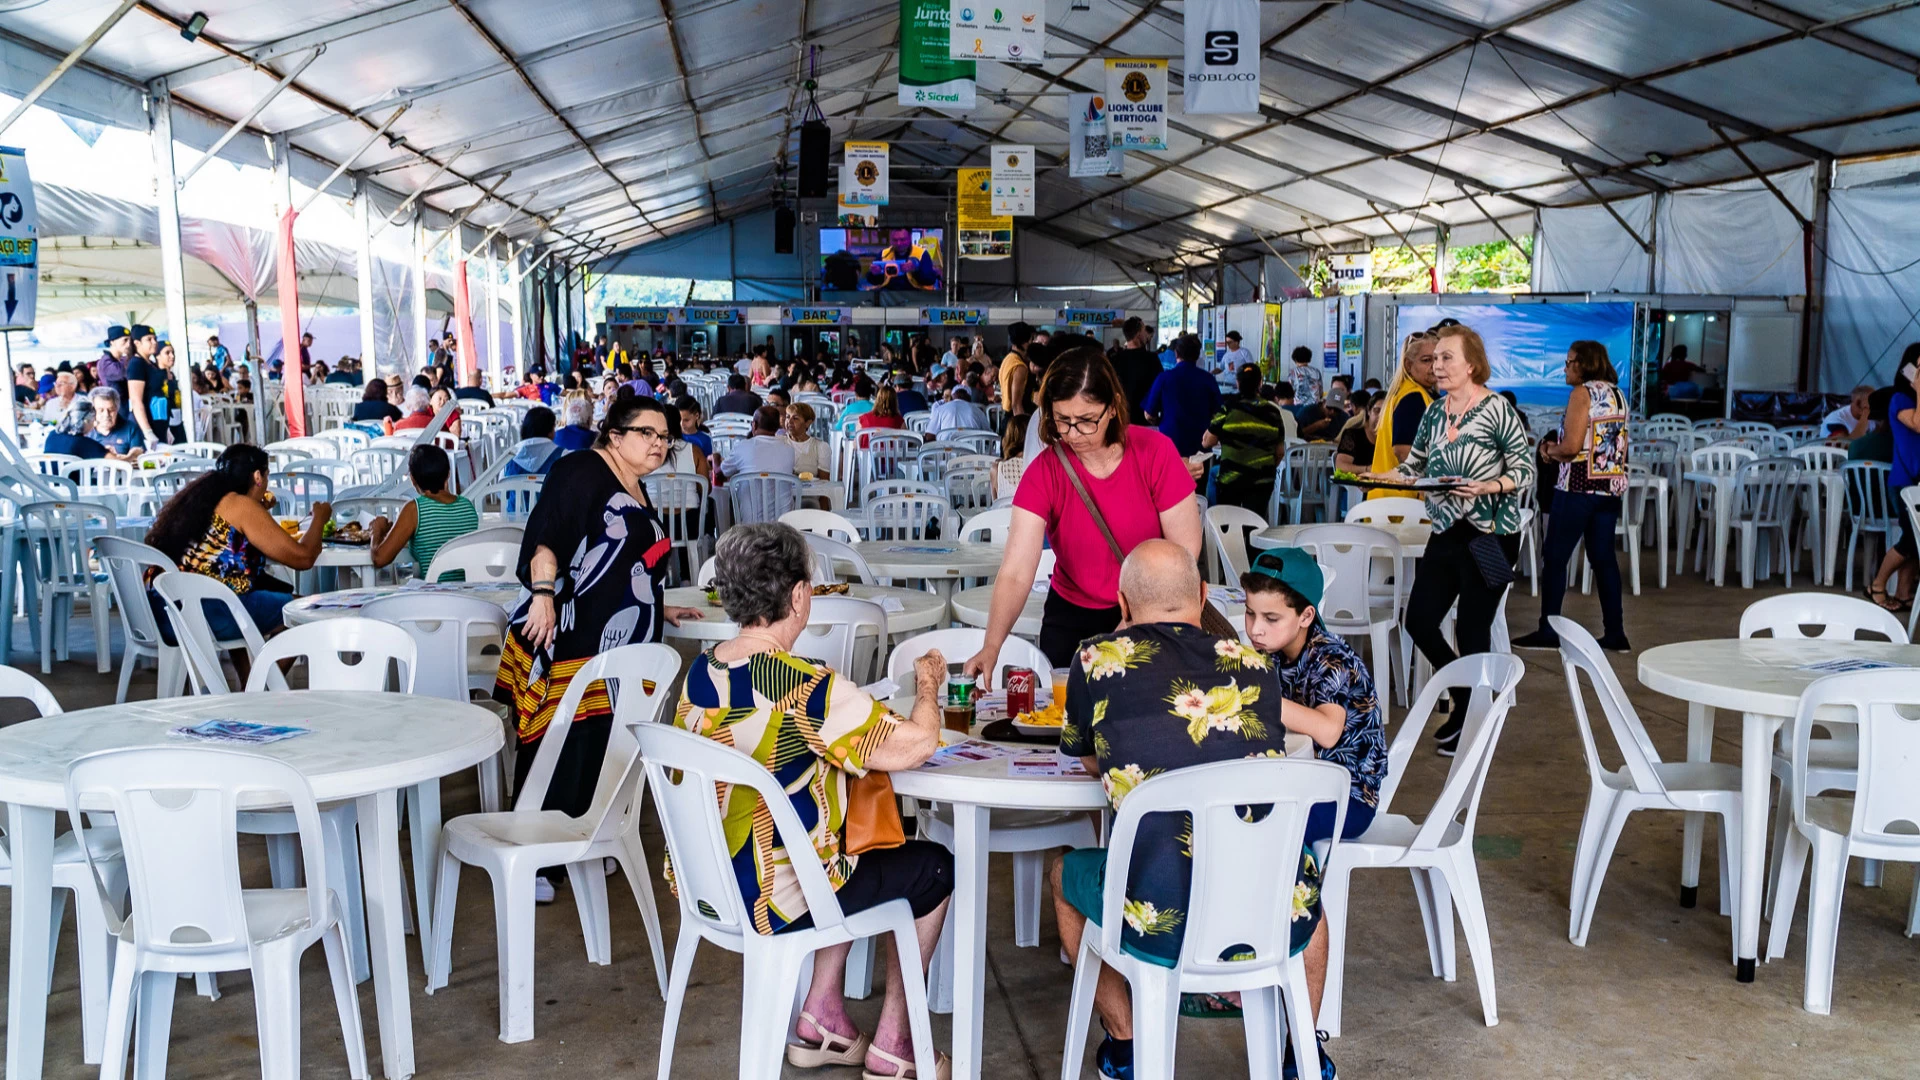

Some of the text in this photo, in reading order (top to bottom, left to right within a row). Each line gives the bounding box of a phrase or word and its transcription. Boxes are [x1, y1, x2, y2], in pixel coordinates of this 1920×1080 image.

[914, 20, 926, 28] por
[984, 24, 1011, 32] Ambientes
[1115, 61, 1147, 69] REALIZAÇÃO
[1188, 73, 1256, 82] SOBLOCO
[928, 92, 959, 101] Sicredi
[1108, 104, 1163, 112] LIONS CLUBE
[1113, 114, 1157, 123] BERTIOGA
[1125, 133, 1160, 144] Bertioga
[17, 239, 32, 255] PET
[619, 310, 665, 319] SORVETES
[694, 310, 730, 319] DOCES
[803, 310, 827, 320] BAR
[940, 311, 966, 320] BAR
[1072, 312, 1110, 322] FRITAS
[1007, 675, 1029, 693] Cola
